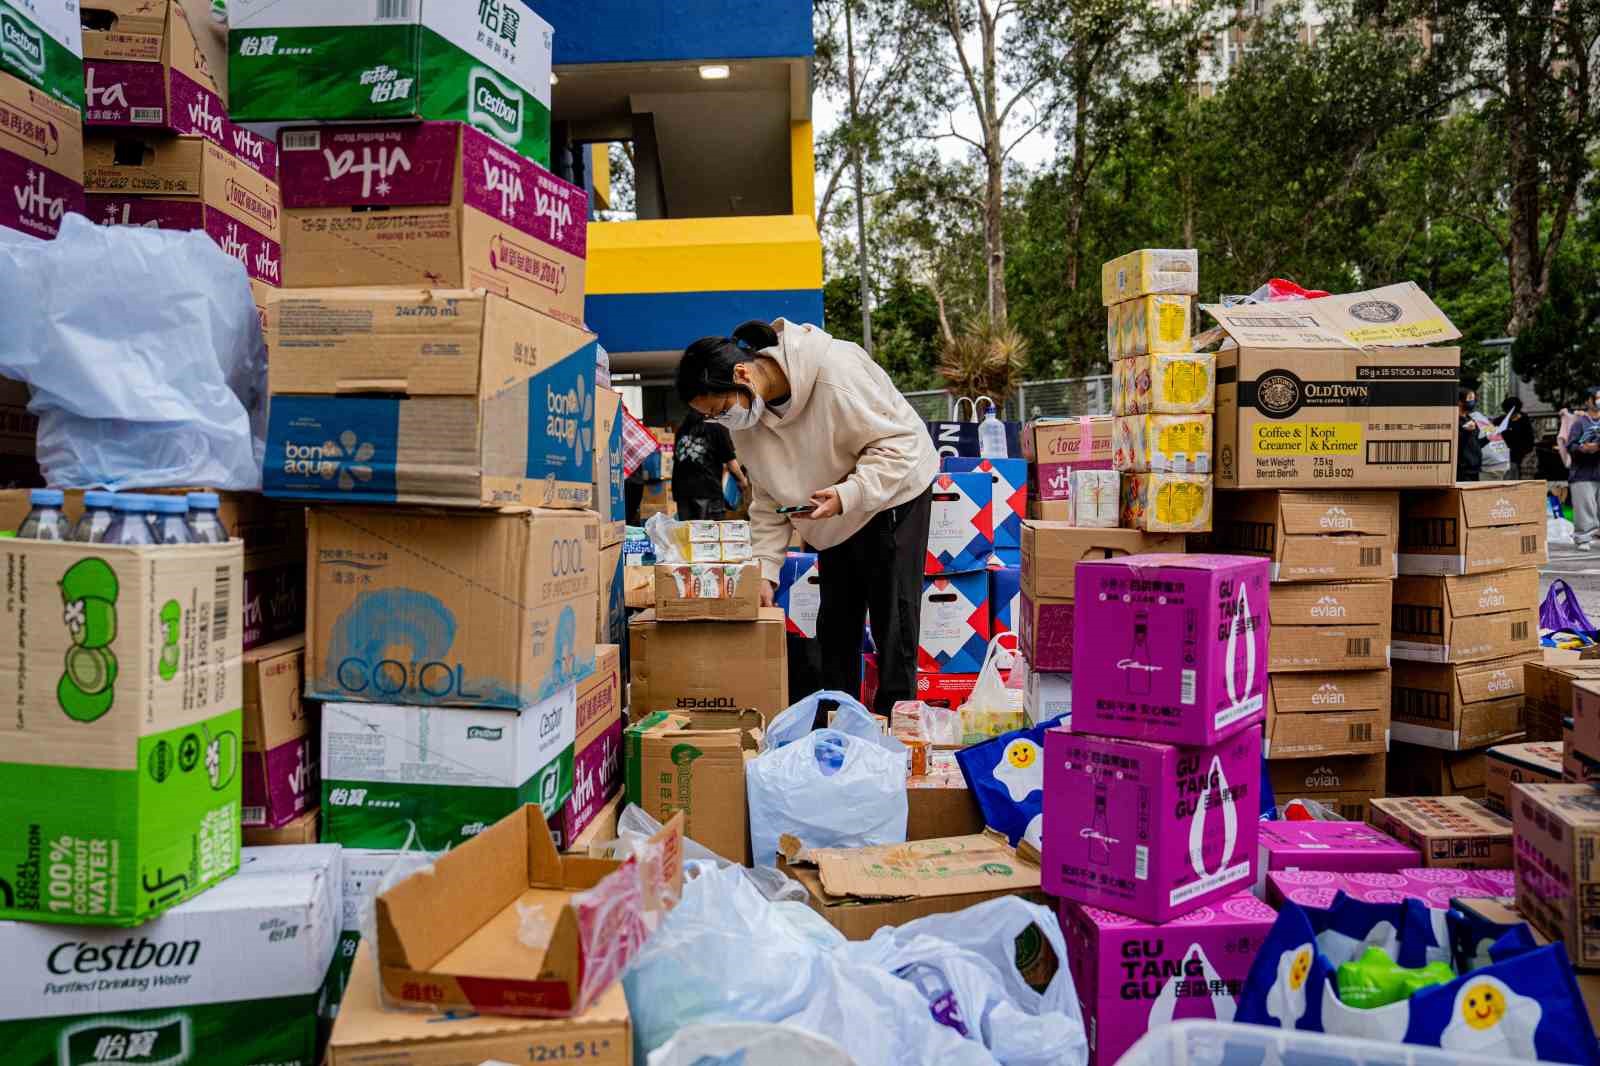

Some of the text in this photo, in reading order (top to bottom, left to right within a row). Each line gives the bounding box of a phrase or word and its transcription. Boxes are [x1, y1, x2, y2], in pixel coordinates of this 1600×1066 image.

[240, 36, 277, 56] 怡寶
[85, 67, 125, 108] ta
[371, 79, 413, 103] 怡寶
[188, 91, 224, 140] vita
[233, 130, 264, 164] vita
[323, 147, 411, 198] vita
[14, 169, 65, 219] vita
[483, 159, 525, 217] vita
[534, 187, 572, 240] vita
[255, 242, 280, 281] vita
[1391, 368, 1415, 376] STICKS
[1421, 368, 1432, 376] 20
[1433, 368, 1455, 376] PACKS
[546, 383, 569, 414] bon
[1258, 427, 1302, 438] Coffee &
[1311, 427, 1335, 440] Kopi
[285, 440, 323, 459] bon
[1258, 440, 1302, 450] Creamer
[1310, 440, 1358, 451] & Krimer
[1256, 458, 1295, 469] Net Weight
[1256, 469, 1298, 478] Berat Bersih
[1319, 517, 1353, 528] evian
[1489, 507, 1516, 520] evian
[1218, 579, 1234, 599] GU
[242, 579, 263, 627] ta
[1218, 597, 1245, 620] TANG
[1311, 606, 1345, 617] evian
[1480, 595, 1505, 609] evian
[1488, 677, 1514, 692] evian
[676, 697, 737, 708] TOPPER
[1311, 693, 1345, 705] evian
[1176, 755, 1200, 777] GU
[571, 759, 595, 815] vita
[1175, 769, 1220, 797] TANG
[1305, 774, 1341, 787] evian
[329, 788, 367, 807] 怡寶
[1175, 797, 1200, 819] GU
[29, 824, 41, 911] SENSATION
[48, 834, 73, 912] 100%
[75, 838, 88, 914] COCONUT
[88, 839, 108, 914] WATER
[47, 937, 201, 975] C'estbon
[1121, 938, 1163, 959] GU
[1120, 959, 1204, 980] TANG
[44, 973, 192, 995] Purified Drinking Water
[1120, 980, 1164, 1000] GU
[94, 1031, 159, 1061] 怡寶
[528, 1041, 585, 1060] 12x1.5
